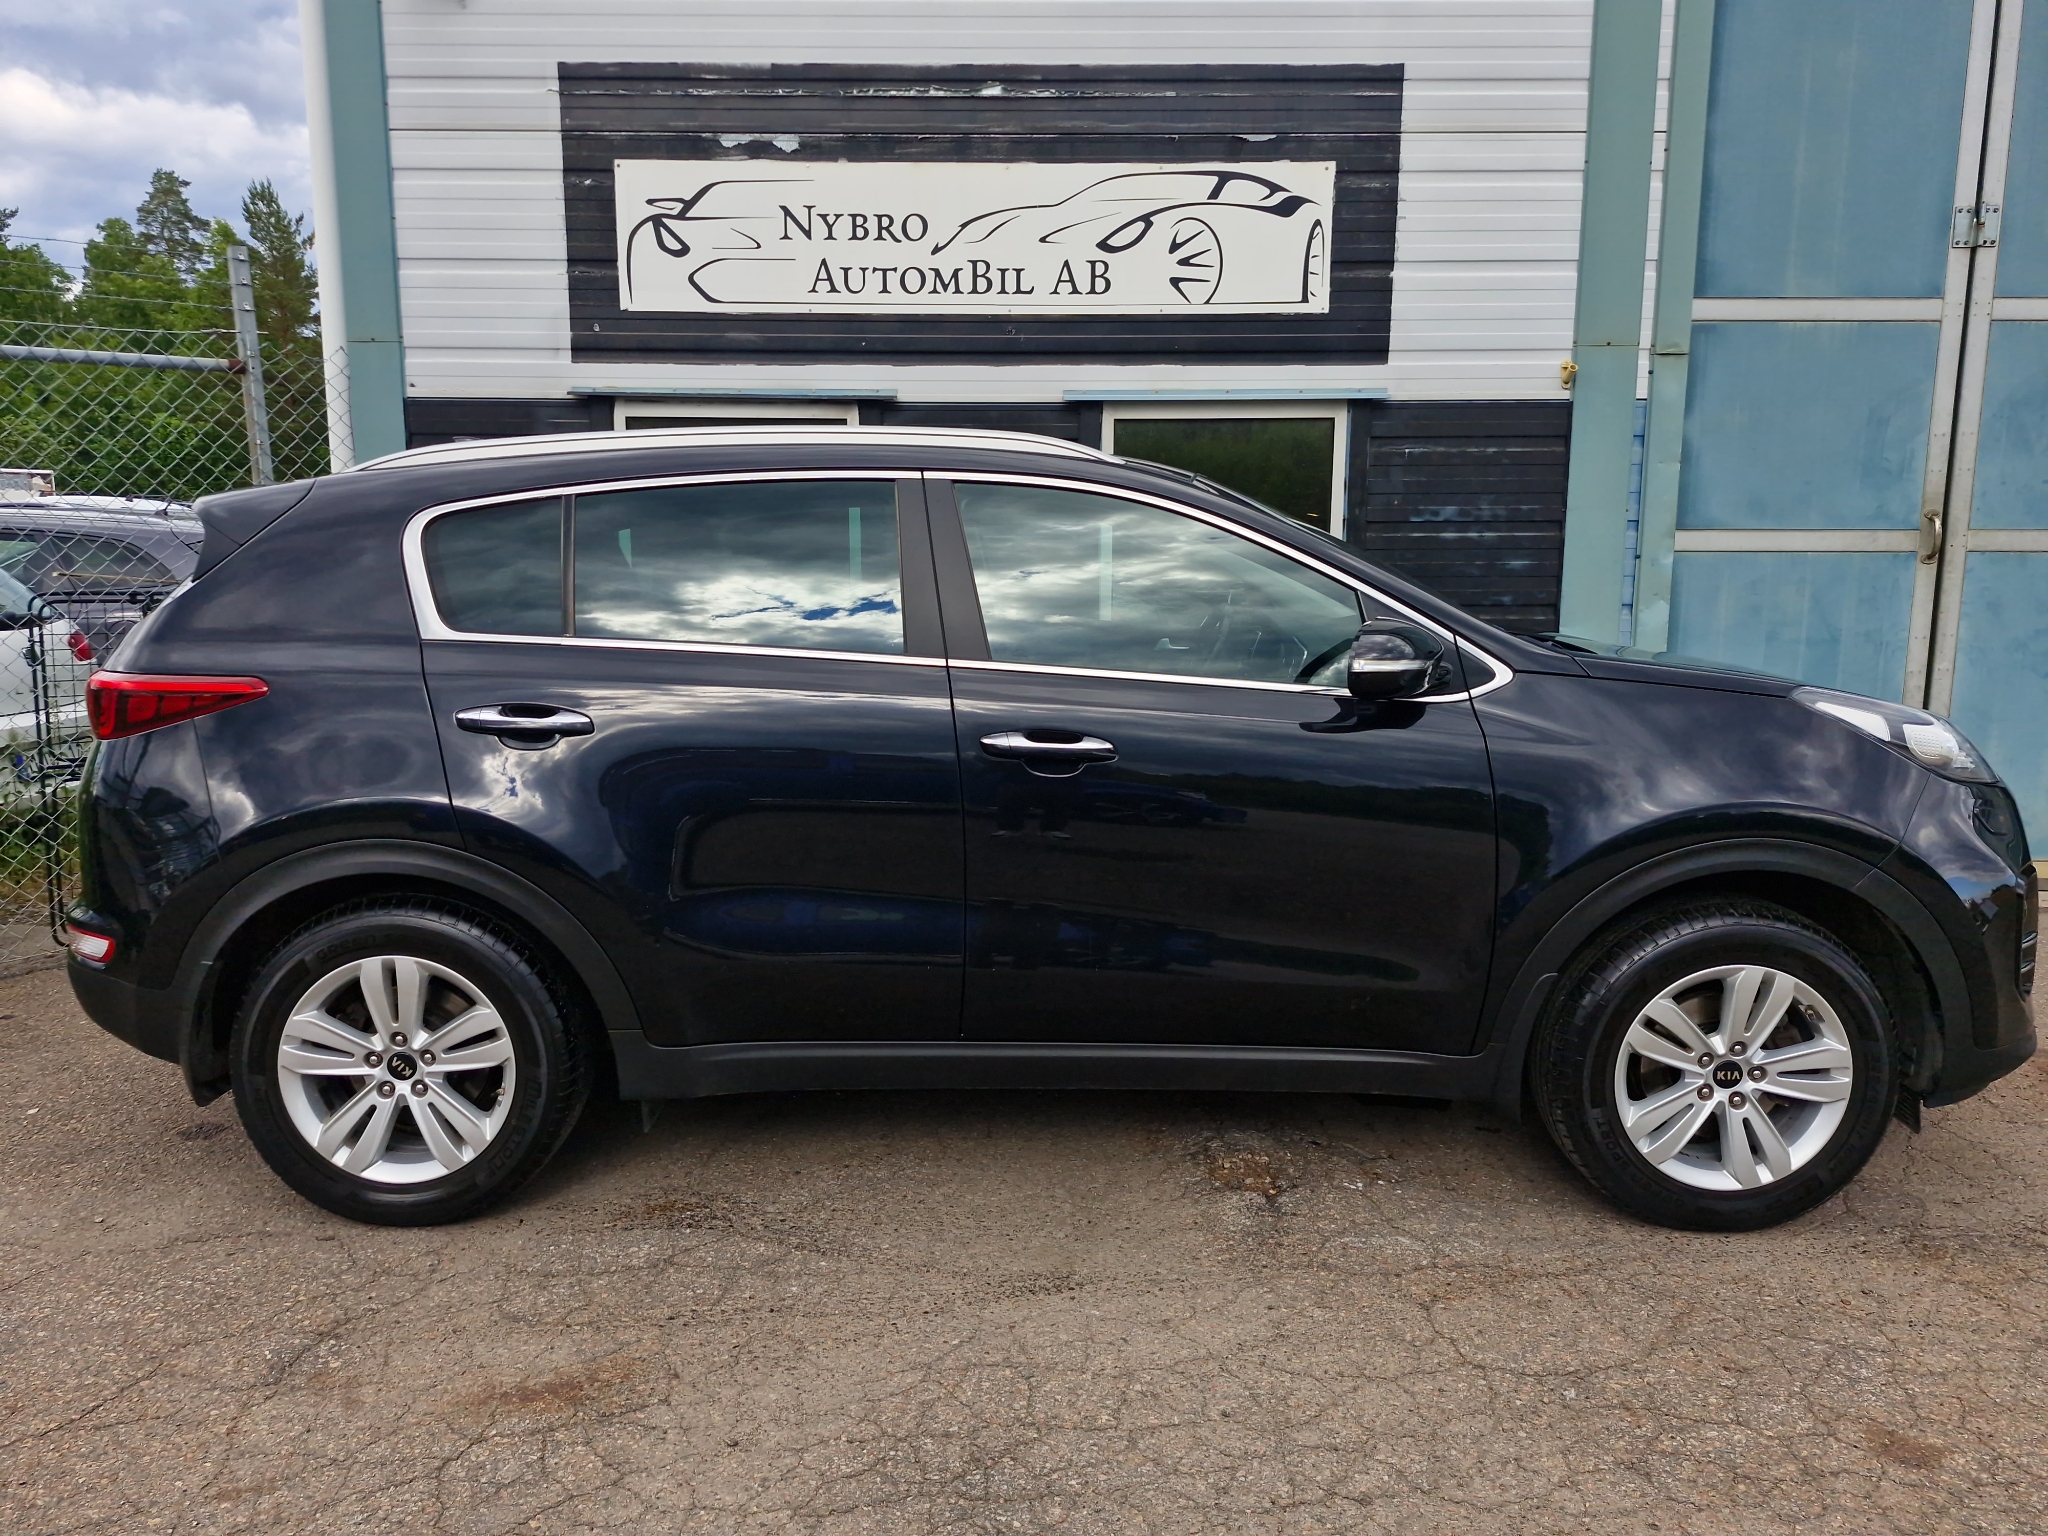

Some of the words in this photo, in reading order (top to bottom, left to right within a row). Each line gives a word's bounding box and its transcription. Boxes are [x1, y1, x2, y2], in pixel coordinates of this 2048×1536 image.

[778, 204, 929, 243] NYBRO
[1049, 259, 1112, 295] AB
[391, 1056, 413, 1078] KIA
[1716, 1070, 1741, 1081] KIA
